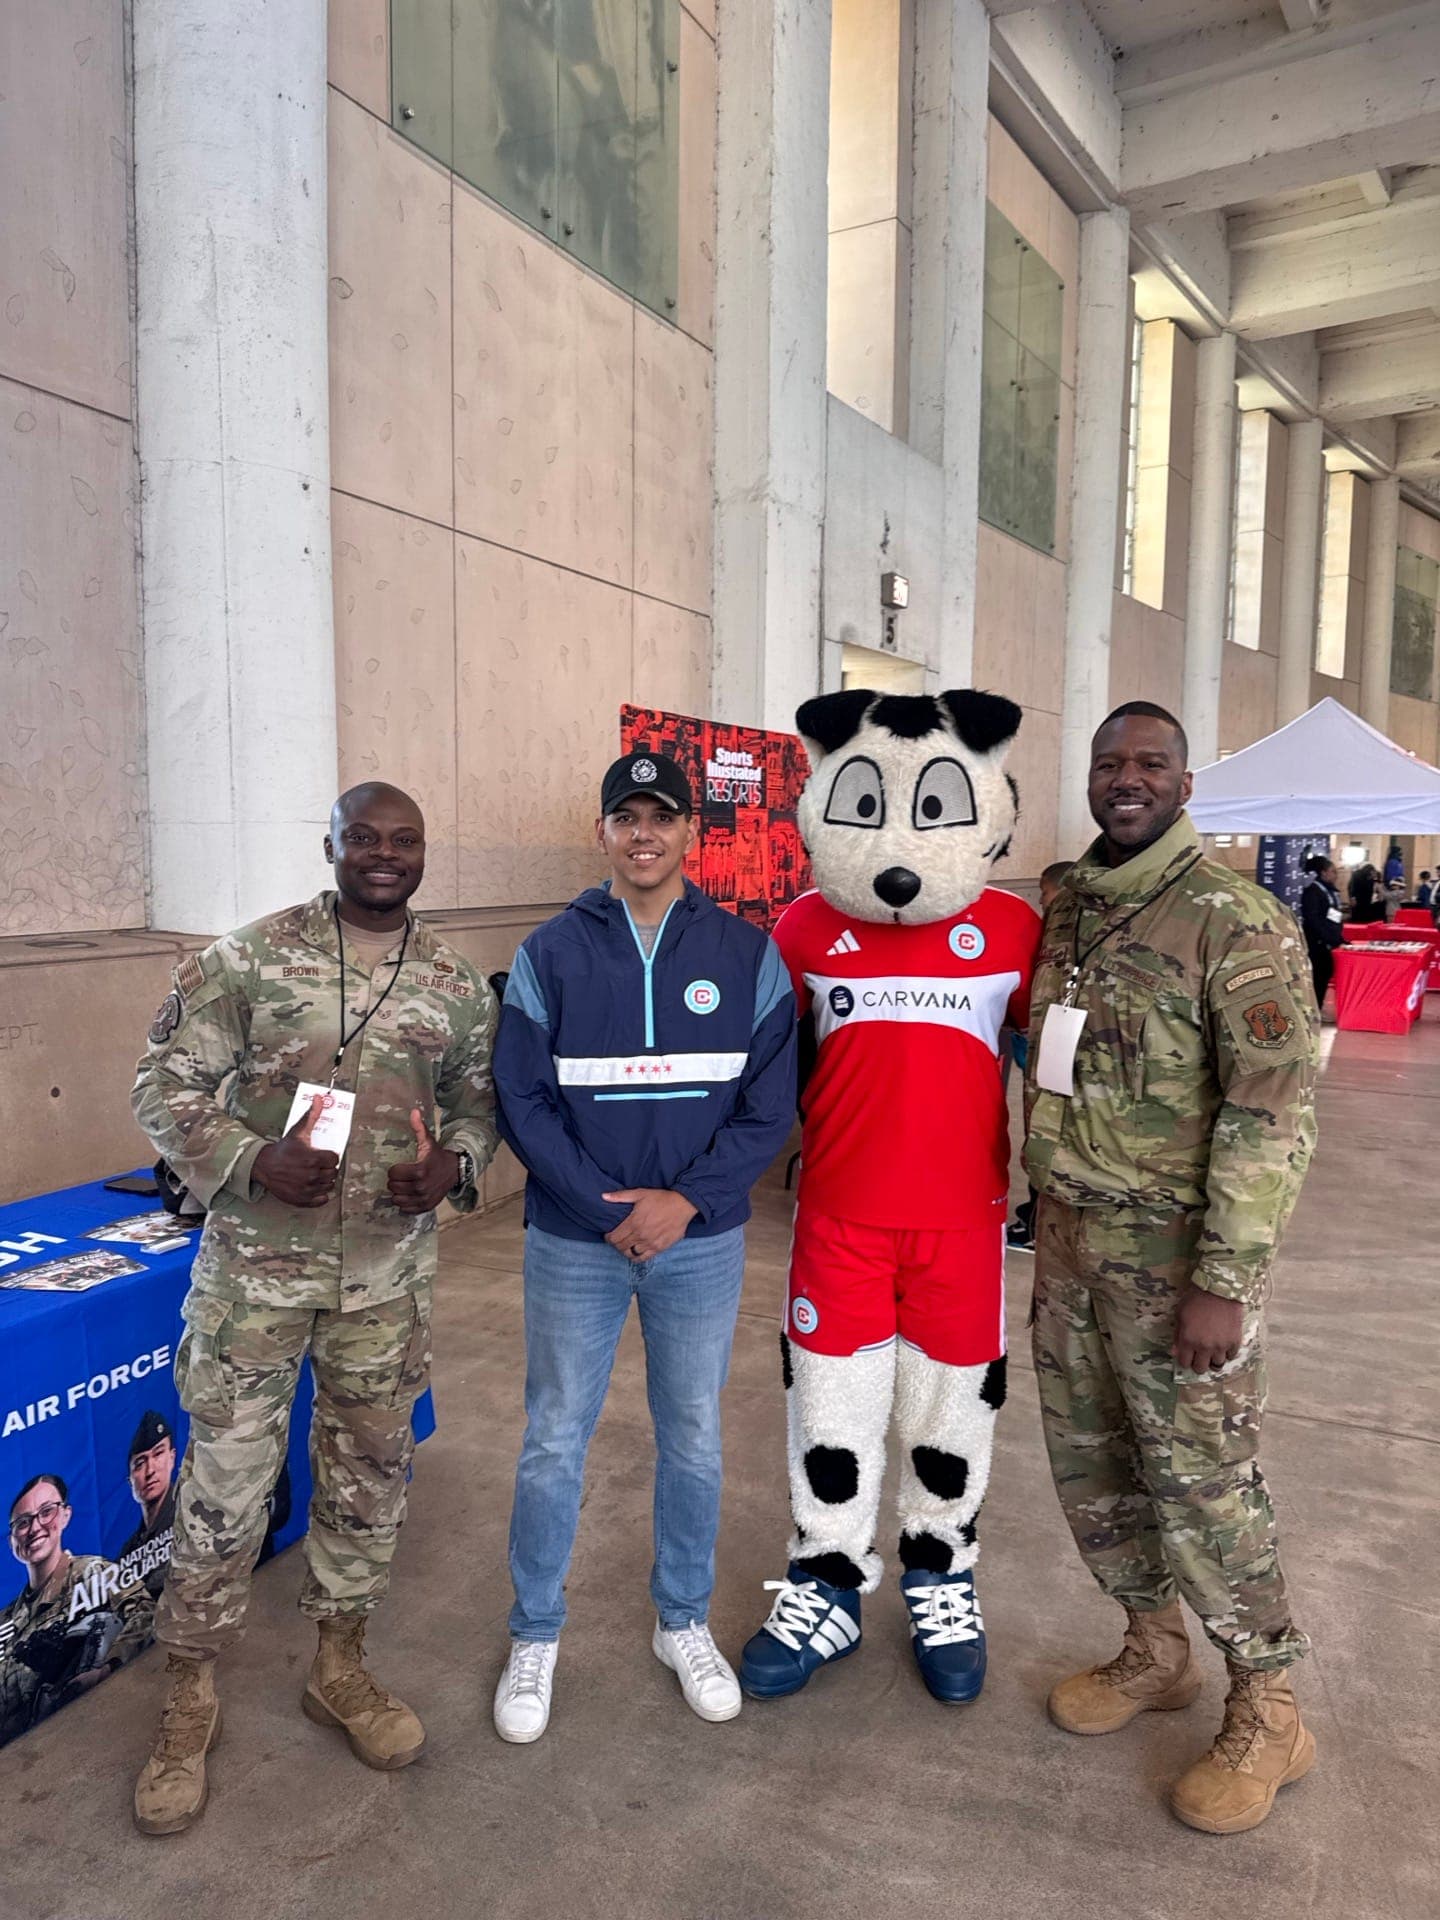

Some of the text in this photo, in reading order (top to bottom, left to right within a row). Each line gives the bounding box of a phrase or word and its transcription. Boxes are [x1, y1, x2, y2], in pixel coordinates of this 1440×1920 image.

[886, 617, 894, 644] 5
[716, 747, 753, 767] Sports
[706, 759, 762, 782] Illustrated
[706, 778, 762, 804] RESORTS
[1263, 851, 1276, 884] FIRE
[282, 966, 320, 978] BROWN
[430, 977, 444, 990] AIR
[445, 980, 471, 998] FORCE
[862, 991, 971, 1011] CARVANA
[1, 1344, 171, 1438] AIR FORCE
[119, 1526, 174, 1571] NATIONAL
[68, 1562, 120, 1624] AIR
